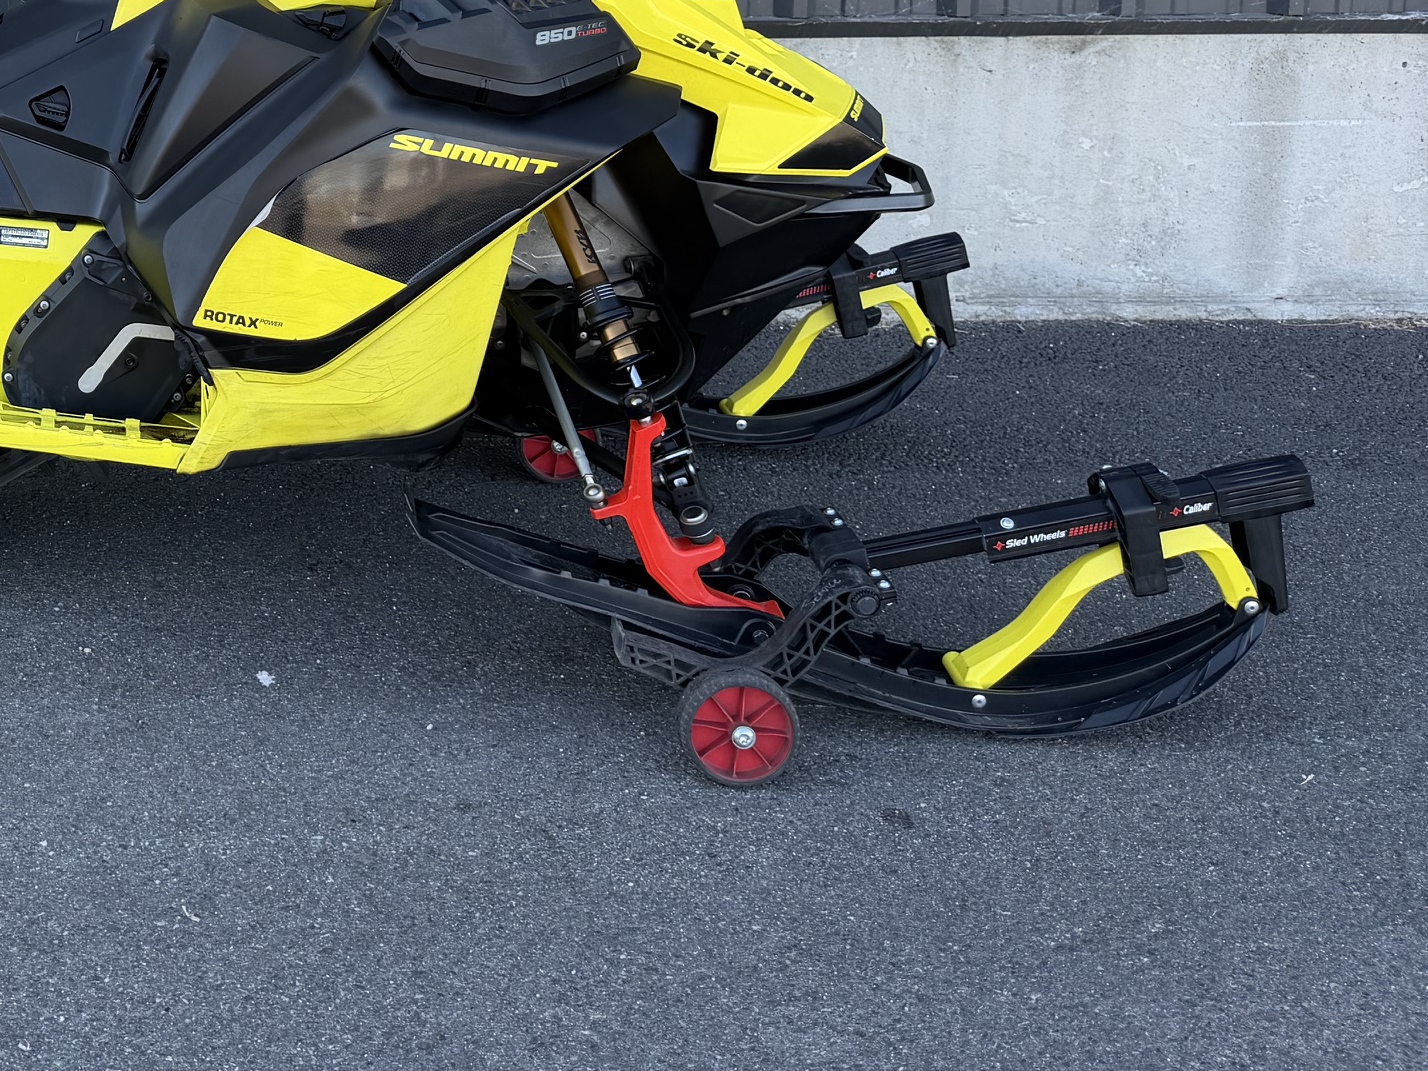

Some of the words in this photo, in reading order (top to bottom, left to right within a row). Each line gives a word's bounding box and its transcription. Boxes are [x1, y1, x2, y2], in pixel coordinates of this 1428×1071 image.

[535, 27, 577, 45] 850
[576, 27, 607, 37] TURBO
[672, 32, 815, 103] ski-doo
[388, 134, 559, 175] SUMMIT
[876, 266, 898, 279] Caliber
[202, 308, 261, 329] ROTAX
[259, 318, 284, 328] POWER
[1182, 501, 1214, 515] Caliber
[1005, 535, 1028, 549] Sled
[1029, 528, 1067, 544] Wheels
